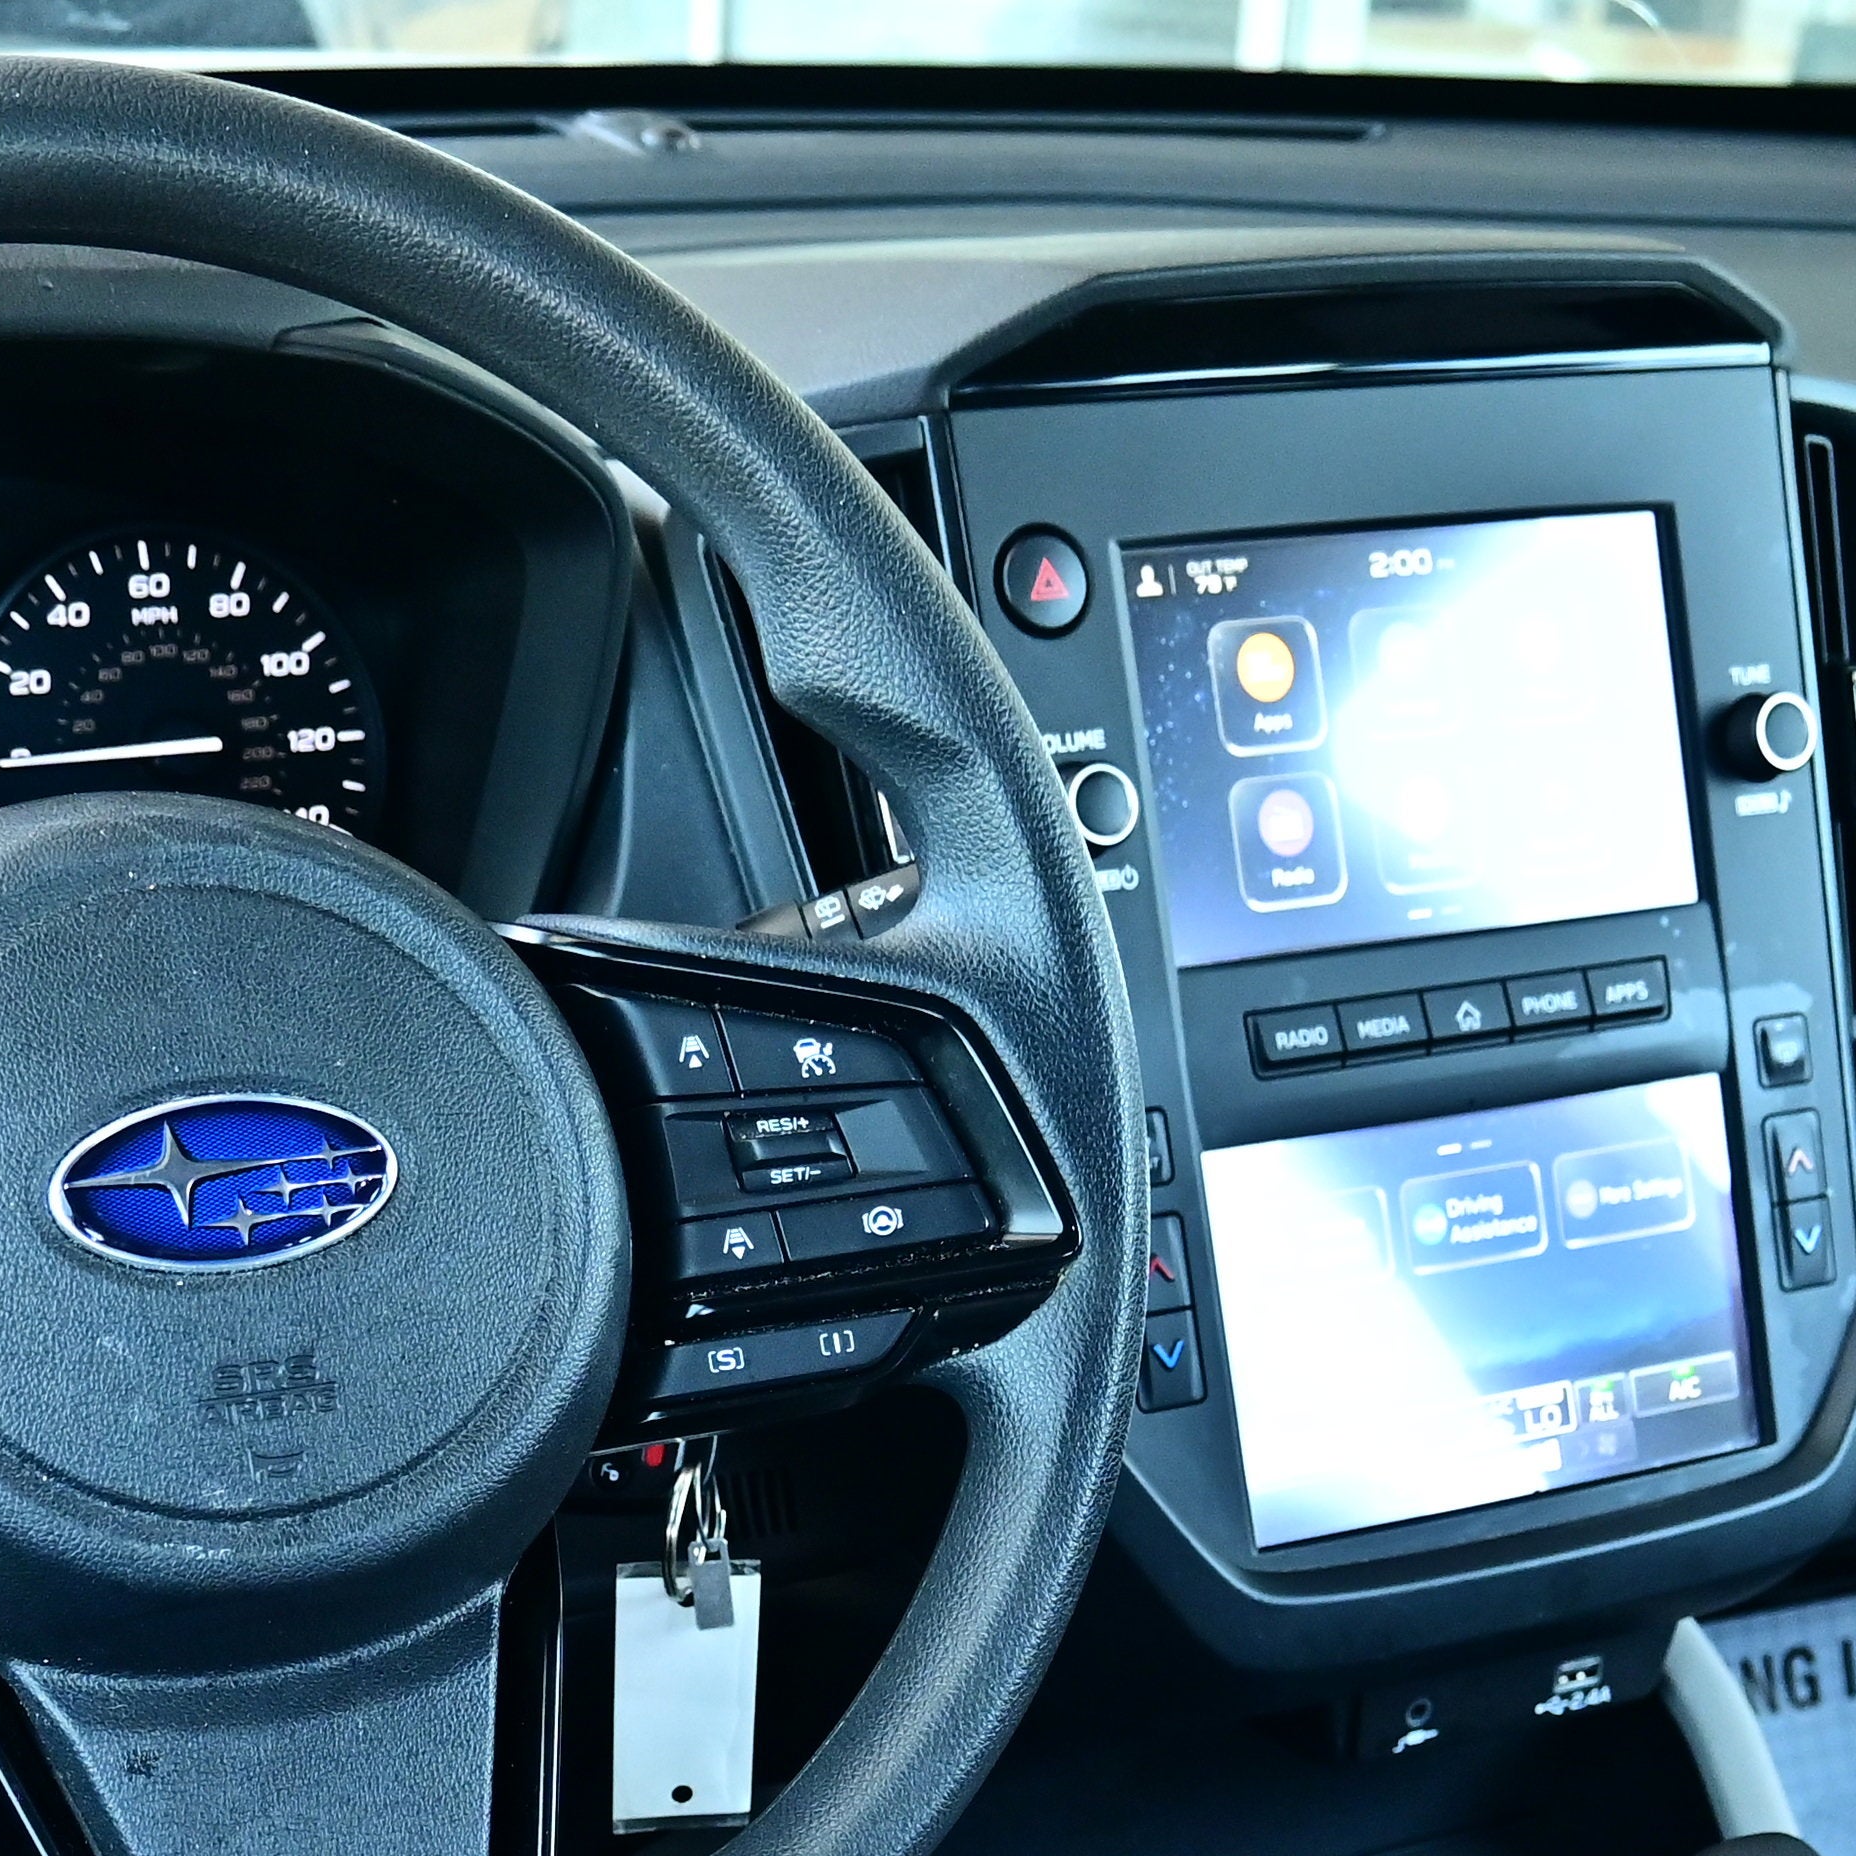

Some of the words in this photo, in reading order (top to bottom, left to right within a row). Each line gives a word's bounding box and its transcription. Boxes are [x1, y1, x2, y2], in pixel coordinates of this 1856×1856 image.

[1368, 548, 1433, 578] 2:00
[128, 573, 171, 598] 60
[46, 602, 90, 628] 40
[131, 606, 178, 626] MPH
[208, 593, 251, 618] 80
[260, 651, 310, 677] 100
[9, 670, 51, 694] 20
[287, 726, 336, 753] 120
[1042, 728, 1106, 755] OLUME
[1521, 990, 1579, 1016] PHONE
[1605, 980, 1649, 1004] APPS
[1275, 1026, 1329, 1051] RADIO
[1357, 1015, 1410, 1040] MEDIA
[756, 1115, 809, 1134] RES/+
[212, 1355, 318, 1395] SRS
